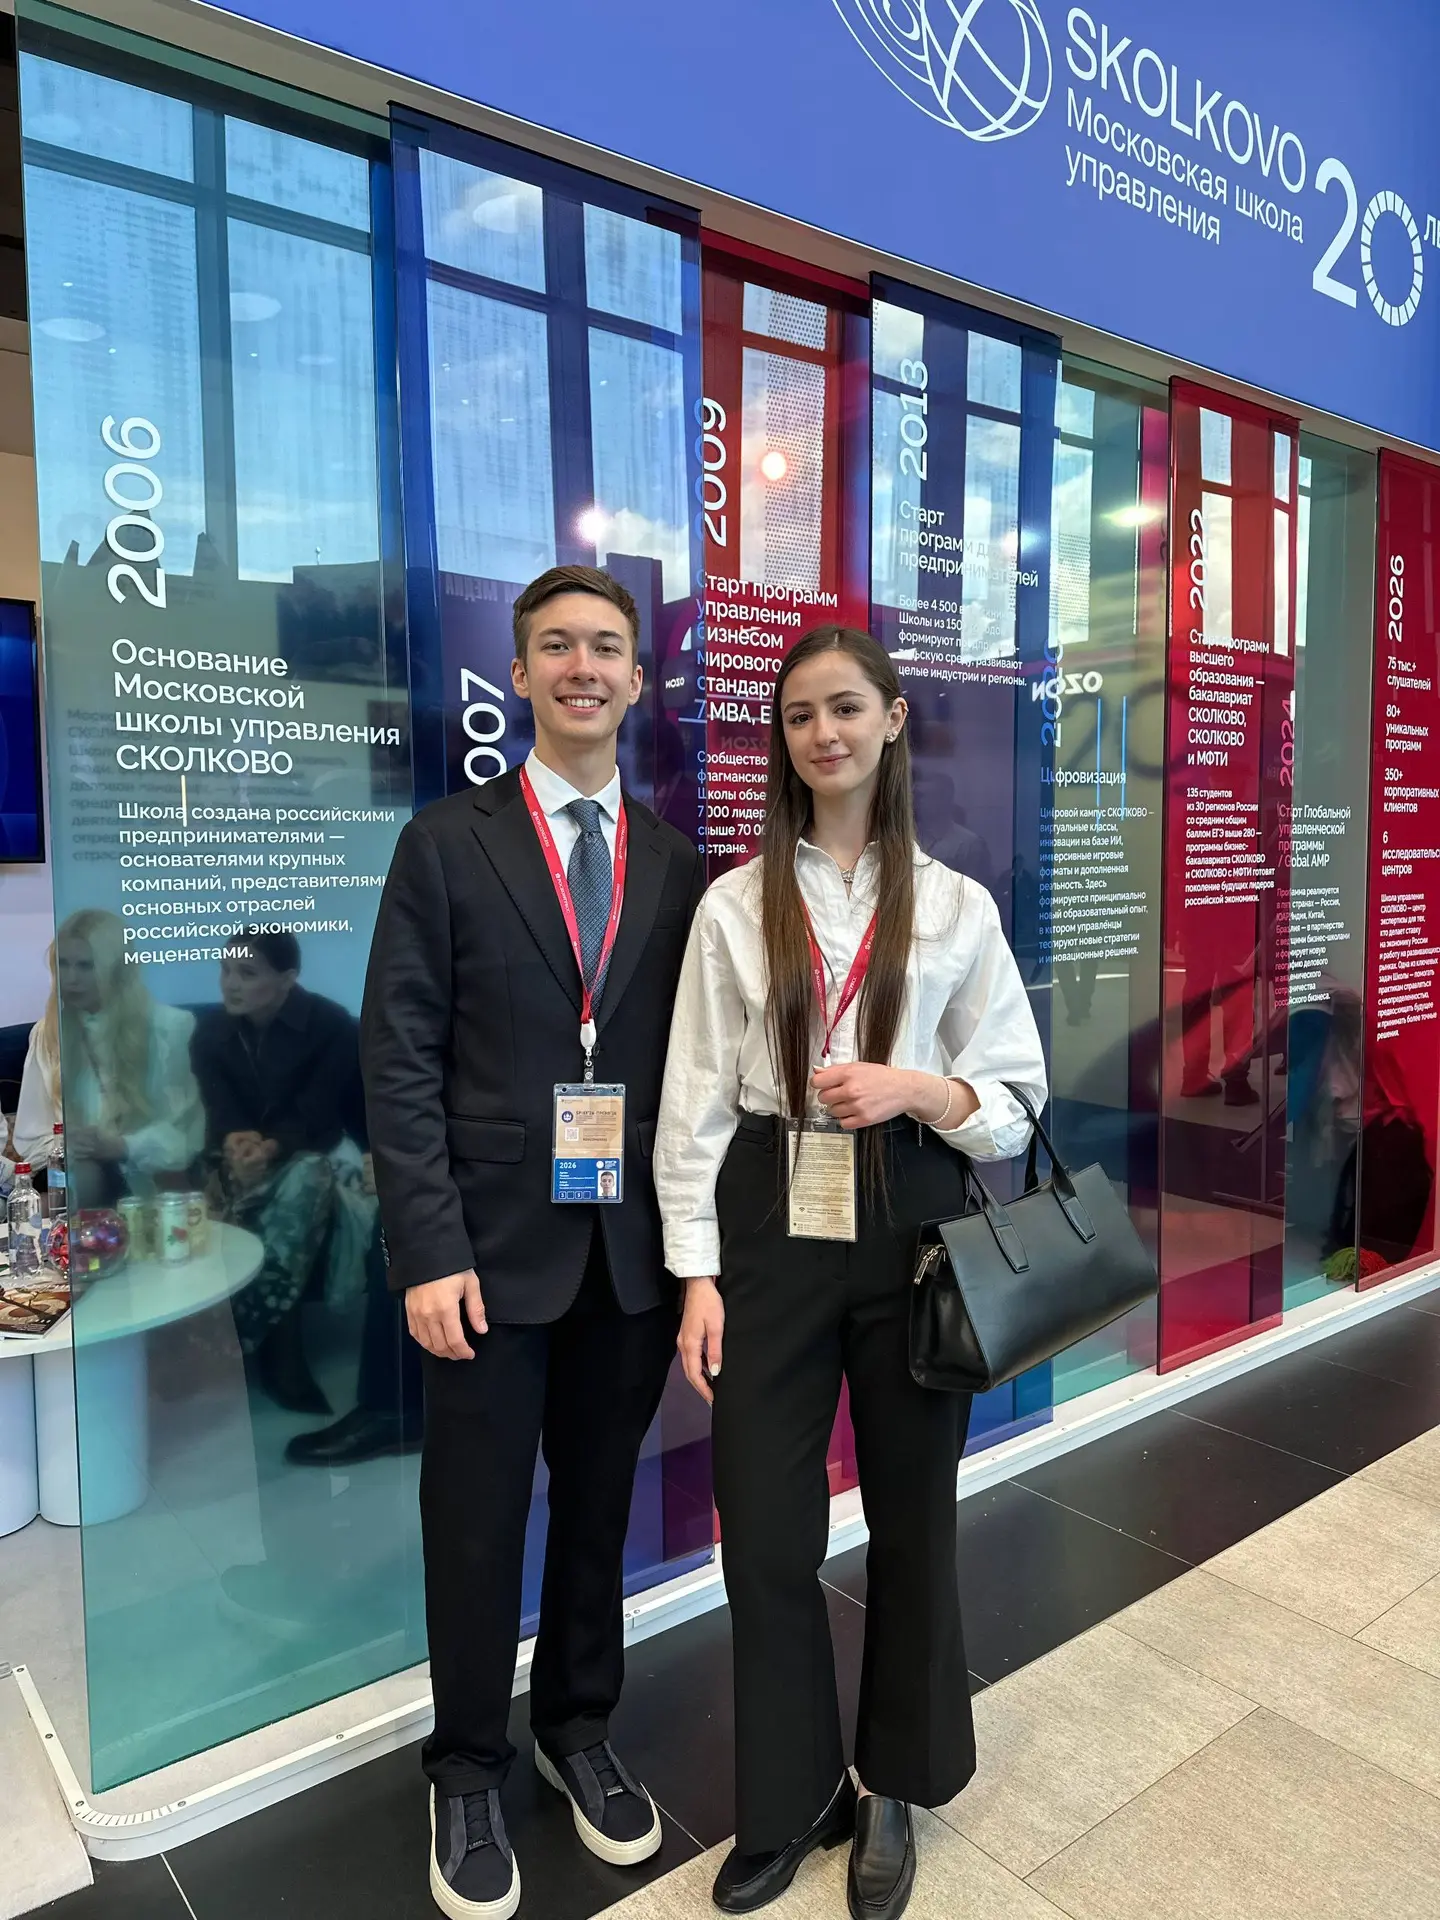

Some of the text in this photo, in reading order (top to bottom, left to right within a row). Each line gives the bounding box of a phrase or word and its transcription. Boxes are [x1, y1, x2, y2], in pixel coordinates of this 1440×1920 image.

[1065, 8, 1307, 194] SKOLKOVO
[1066, 88, 1304, 244] Московская школа
[1065, 145, 1221, 245] управления
[1312, 157, 1424, 327] 20
[900, 358, 929, 481] 2013
[693, 397, 727, 547] 2009
[101, 414, 167, 609] 2006
[900, 500, 945, 528] Старт
[1189, 508, 1209, 612] 2022
[696, 569, 838, 608] Старт программ
[899, 594, 958, 613] Более 4 500
[1388, 554, 1405, 643] 2026
[696, 598, 801, 627] управления
[899, 611, 932, 627] Школы
[934, 618, 945, 629] из
[697, 621, 784, 649] бизнесом
[898, 629, 954, 649] формируют
[112, 638, 288, 676] Основание
[697, 650, 783, 673] мирового
[1189, 651, 1235, 667] высшего
[1388, 656, 1397, 670] 75
[898, 665, 1028, 688] целые индустрии регионы.
[1189, 667, 1254, 688] образования
[1387, 675, 1431, 691] слушателей
[114, 671, 304, 709] Московской
[697, 675, 777, 700] стандарт
[1189, 685, 1254, 707] бакалавриат
[710, 701, 756, 726] MBA,
[1188, 707, 1247, 727] СКОЛКОВО,
[1386, 703, 1401, 718] 80+
[115, 711, 400, 745] школы управления
[460, 668, 508, 786] 007
[1385, 722, 1429, 737] уникальных
[1188, 728, 1245, 746] СКОЛКОВО
[1385, 738, 1422, 753] программ
[116, 744, 293, 775] СКОЛКОВО
[697, 751, 769, 766] Сообщество
[1197, 750, 1228, 767] МФТИ
[1384, 767, 1403, 781] 350+
[738, 788, 767, 801] объе
[1186, 787, 1233, 800] 135 студентов
[1384, 786, 1440, 801] корпоративных
[118, 802, 395, 824] Школа создана российскими
[731, 808, 767, 821] лидер
[1107, 807, 1148, 817] СКОЛКОВО
[1186, 801, 1259, 814] из 30 регионов России
[1304, 804, 1351, 819] Глобальной
[1384, 802, 1418, 813] клиентов
[119, 829, 325, 847] предпринимателями
[737, 823, 751, 836] 70
[1212, 828, 1224, 838] ЕГЭ
[1278, 822, 1346, 838] упавленческой
[1382, 830, 1389, 844] 6
[1081, 838, 1091, 846] на
[1091, 836, 1109, 846] базе
[120, 851, 346, 869] основателями крупных
[1093, 851, 1124, 862] игровые
[1231, 854, 1266, 864] СКОЛКОВО
[1284, 853, 1330, 867] Gobal AMP
[1382, 849, 1440, 861] исследовательс
[1080, 865, 1129, 876] дополненная
[1191, 868, 1227, 879] СКОЛКОВО
[1382, 864, 1413, 878] центров
[121, 874, 227, 893] компаний,
[1085, 878, 1107, 889] Здесь
[121, 896, 315, 917] основных отраслей
[1089, 891, 1147, 904] принципиально
[1063, 905, 1128, 920] образовательный
[123, 917, 354, 944] российской экономики,
[1077, 920, 1122, 933] управленцы
[1079, 936, 1103, 946] новые
[1103, 933, 1140, 948] стратегии
[124, 945, 254, 965] меценатами.
